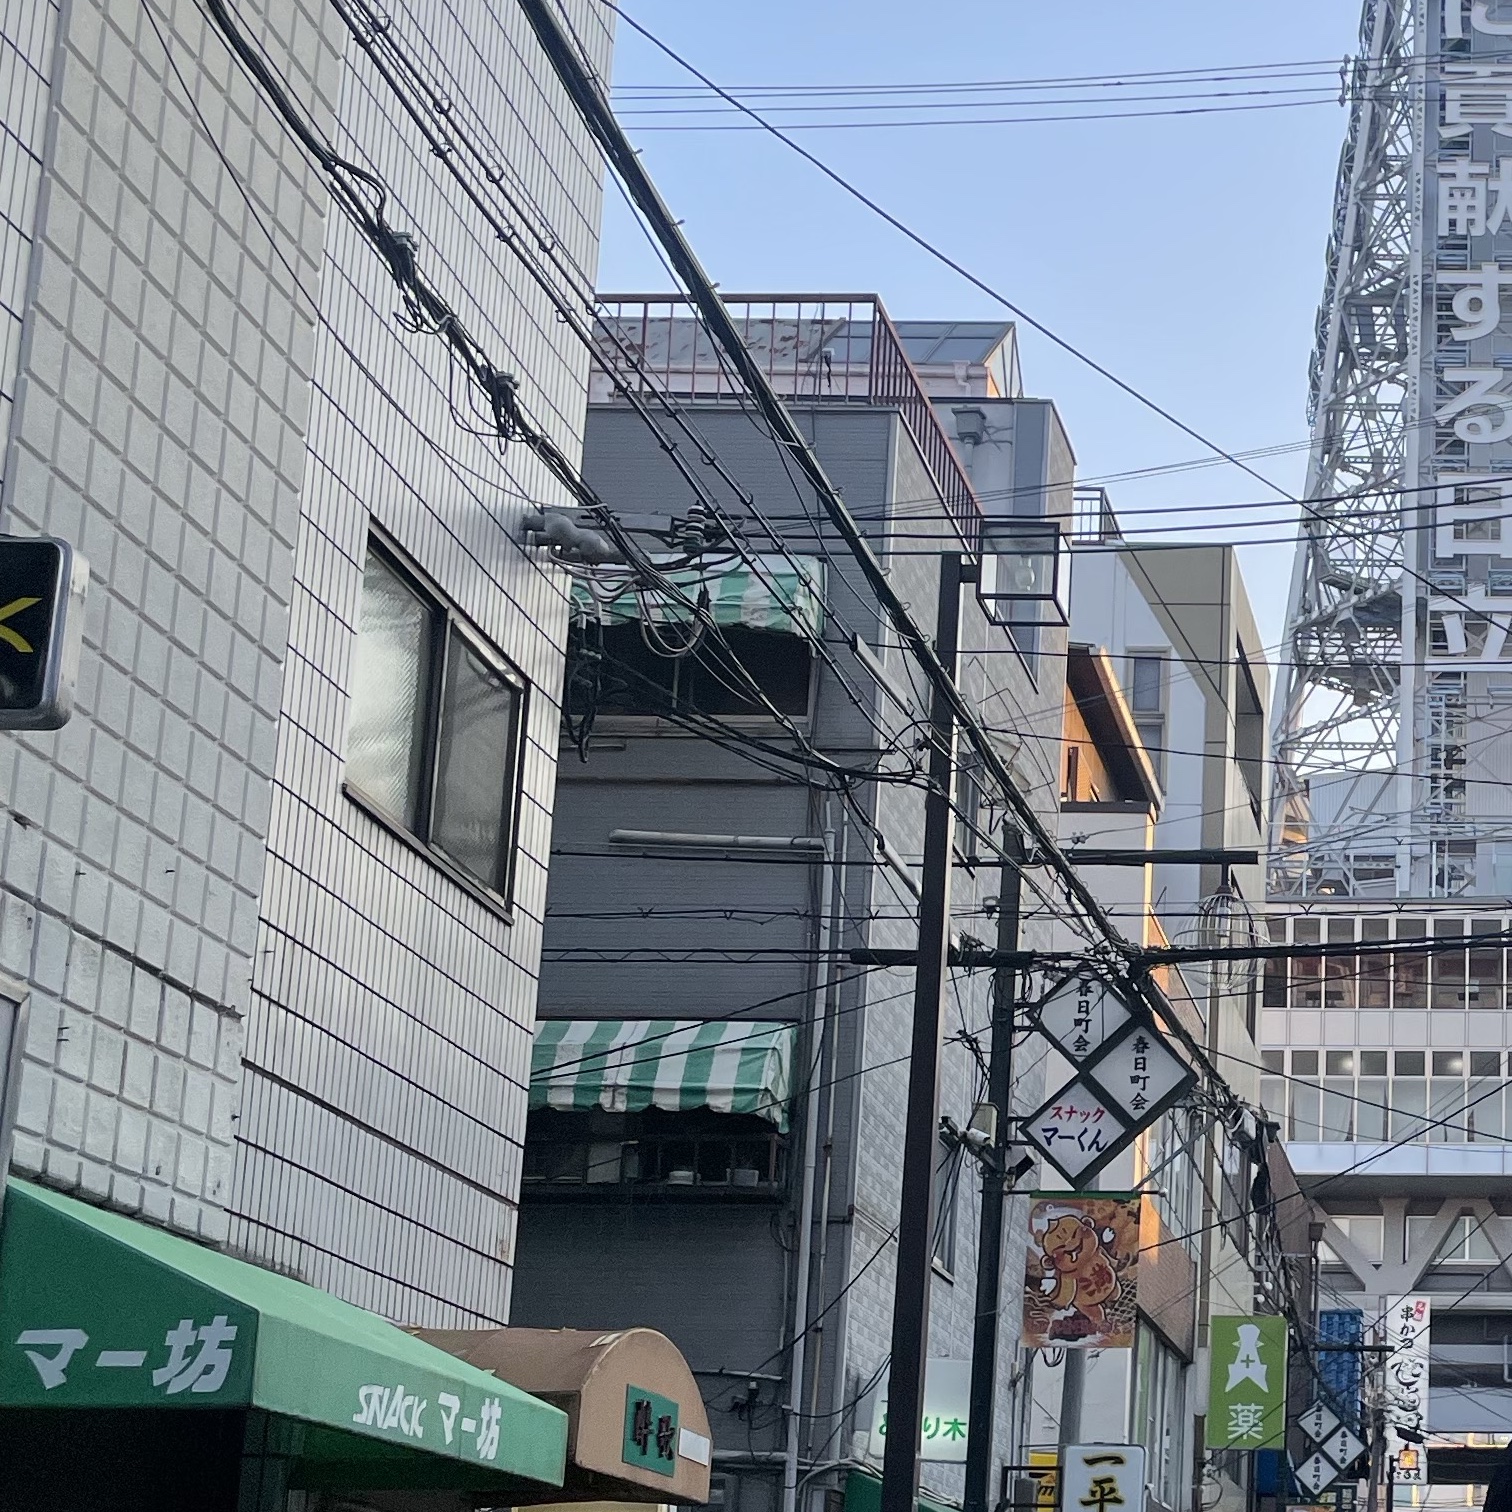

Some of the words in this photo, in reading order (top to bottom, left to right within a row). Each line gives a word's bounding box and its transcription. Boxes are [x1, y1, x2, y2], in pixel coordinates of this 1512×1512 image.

[1073, 979, 1093, 1052] 春日町会
[1129, 1035, 1150, 1110] 春日町会
[1041, 1127, 1108, 1152] マーくん
[1050, 1105, 1105, 1124] スナック
[15, 1315, 238, 1395] マー坊
[352, 1383, 427, 1440] SNACK
[437, 1390, 502, 1460] マー坊
[1227, 1402, 1264, 1440] 薬
